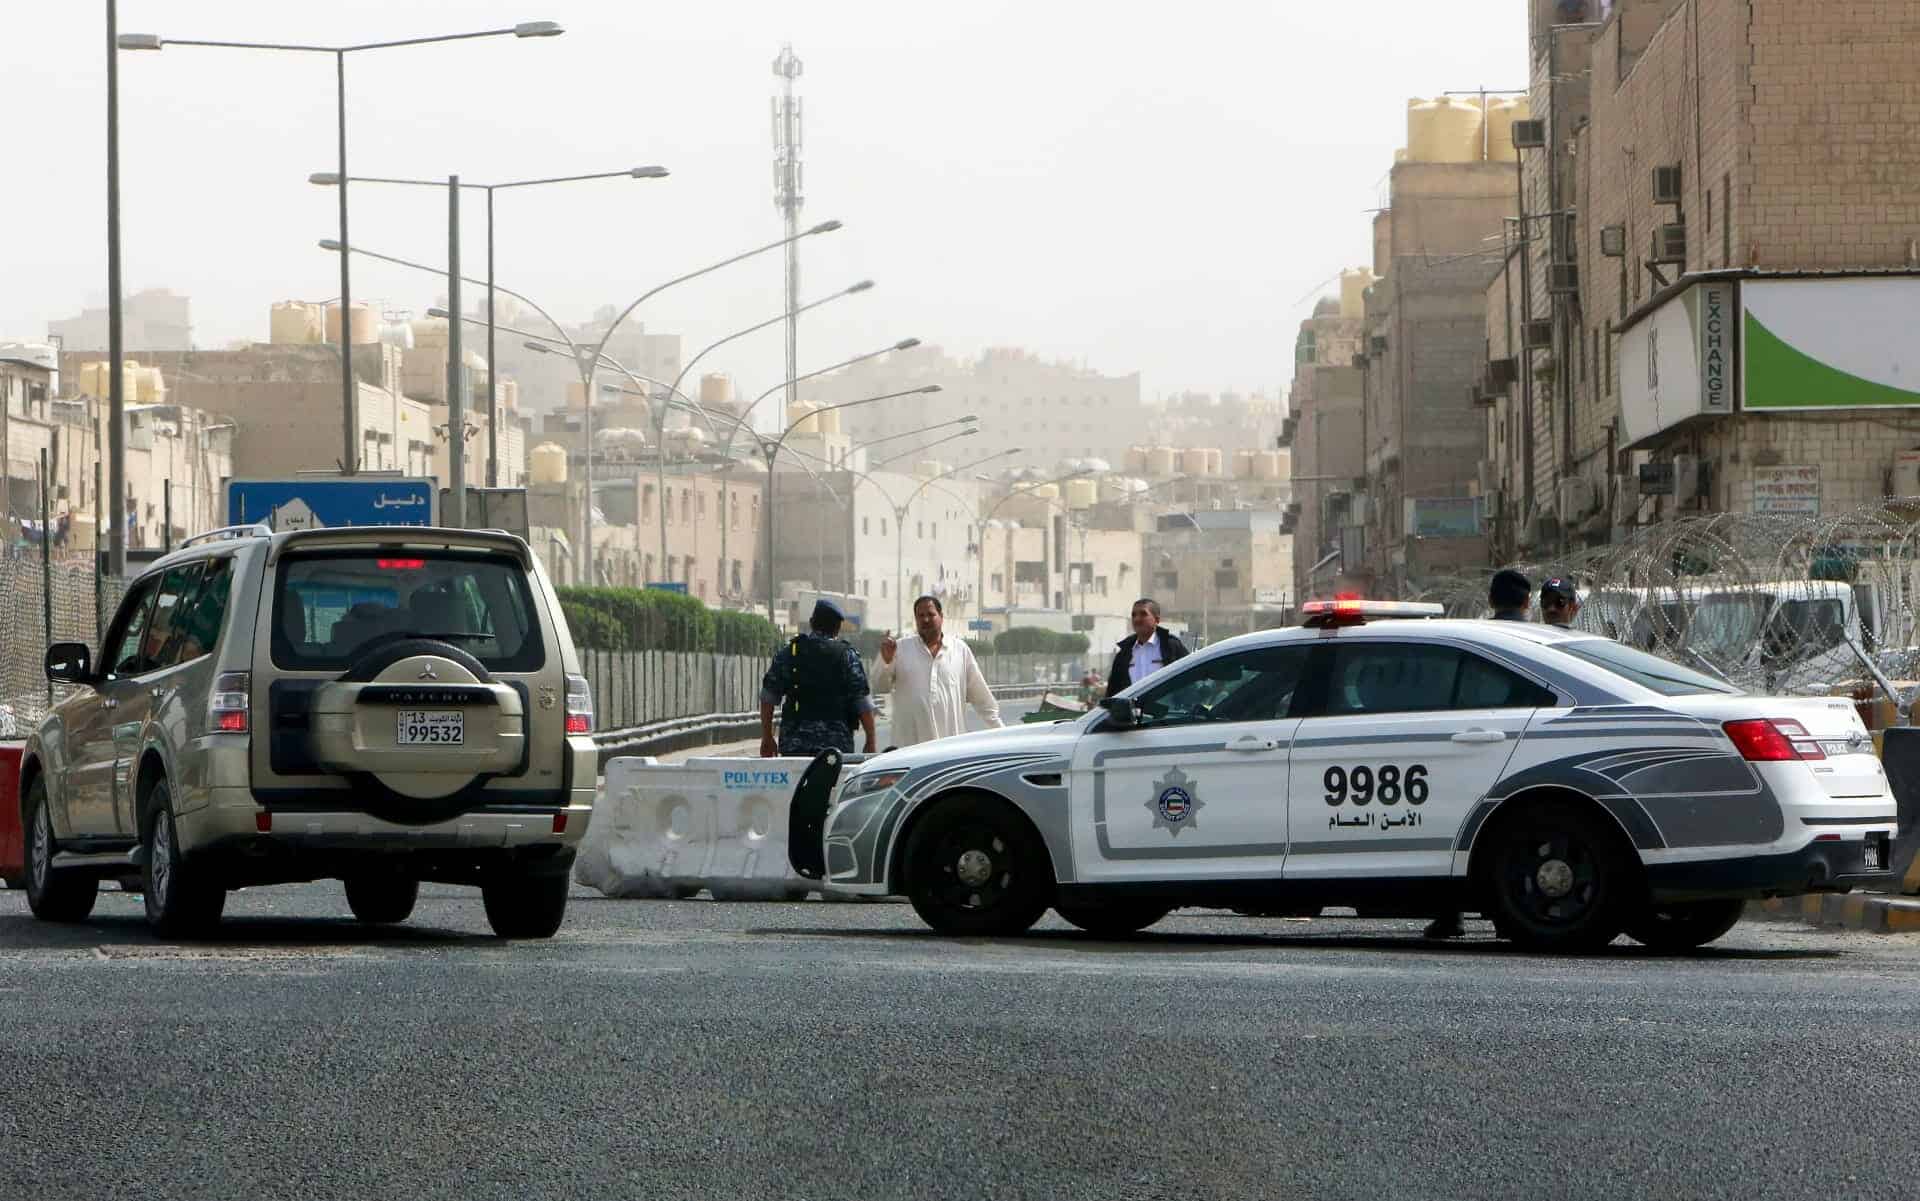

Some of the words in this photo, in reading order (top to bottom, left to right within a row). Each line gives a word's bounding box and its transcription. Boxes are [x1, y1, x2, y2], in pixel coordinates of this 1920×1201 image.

[1707, 290, 1722, 406] EXCHANGE
[374, 493, 425, 509] دليل
[408, 712, 425, 723] 13
[408, 725, 462, 742] 99532
[724, 771, 789, 785] POLYTEX
[1323, 764, 1429, 807] 9986
[1329, 811, 1375, 831] العام
[1381, 808, 1422, 831] الأمن
